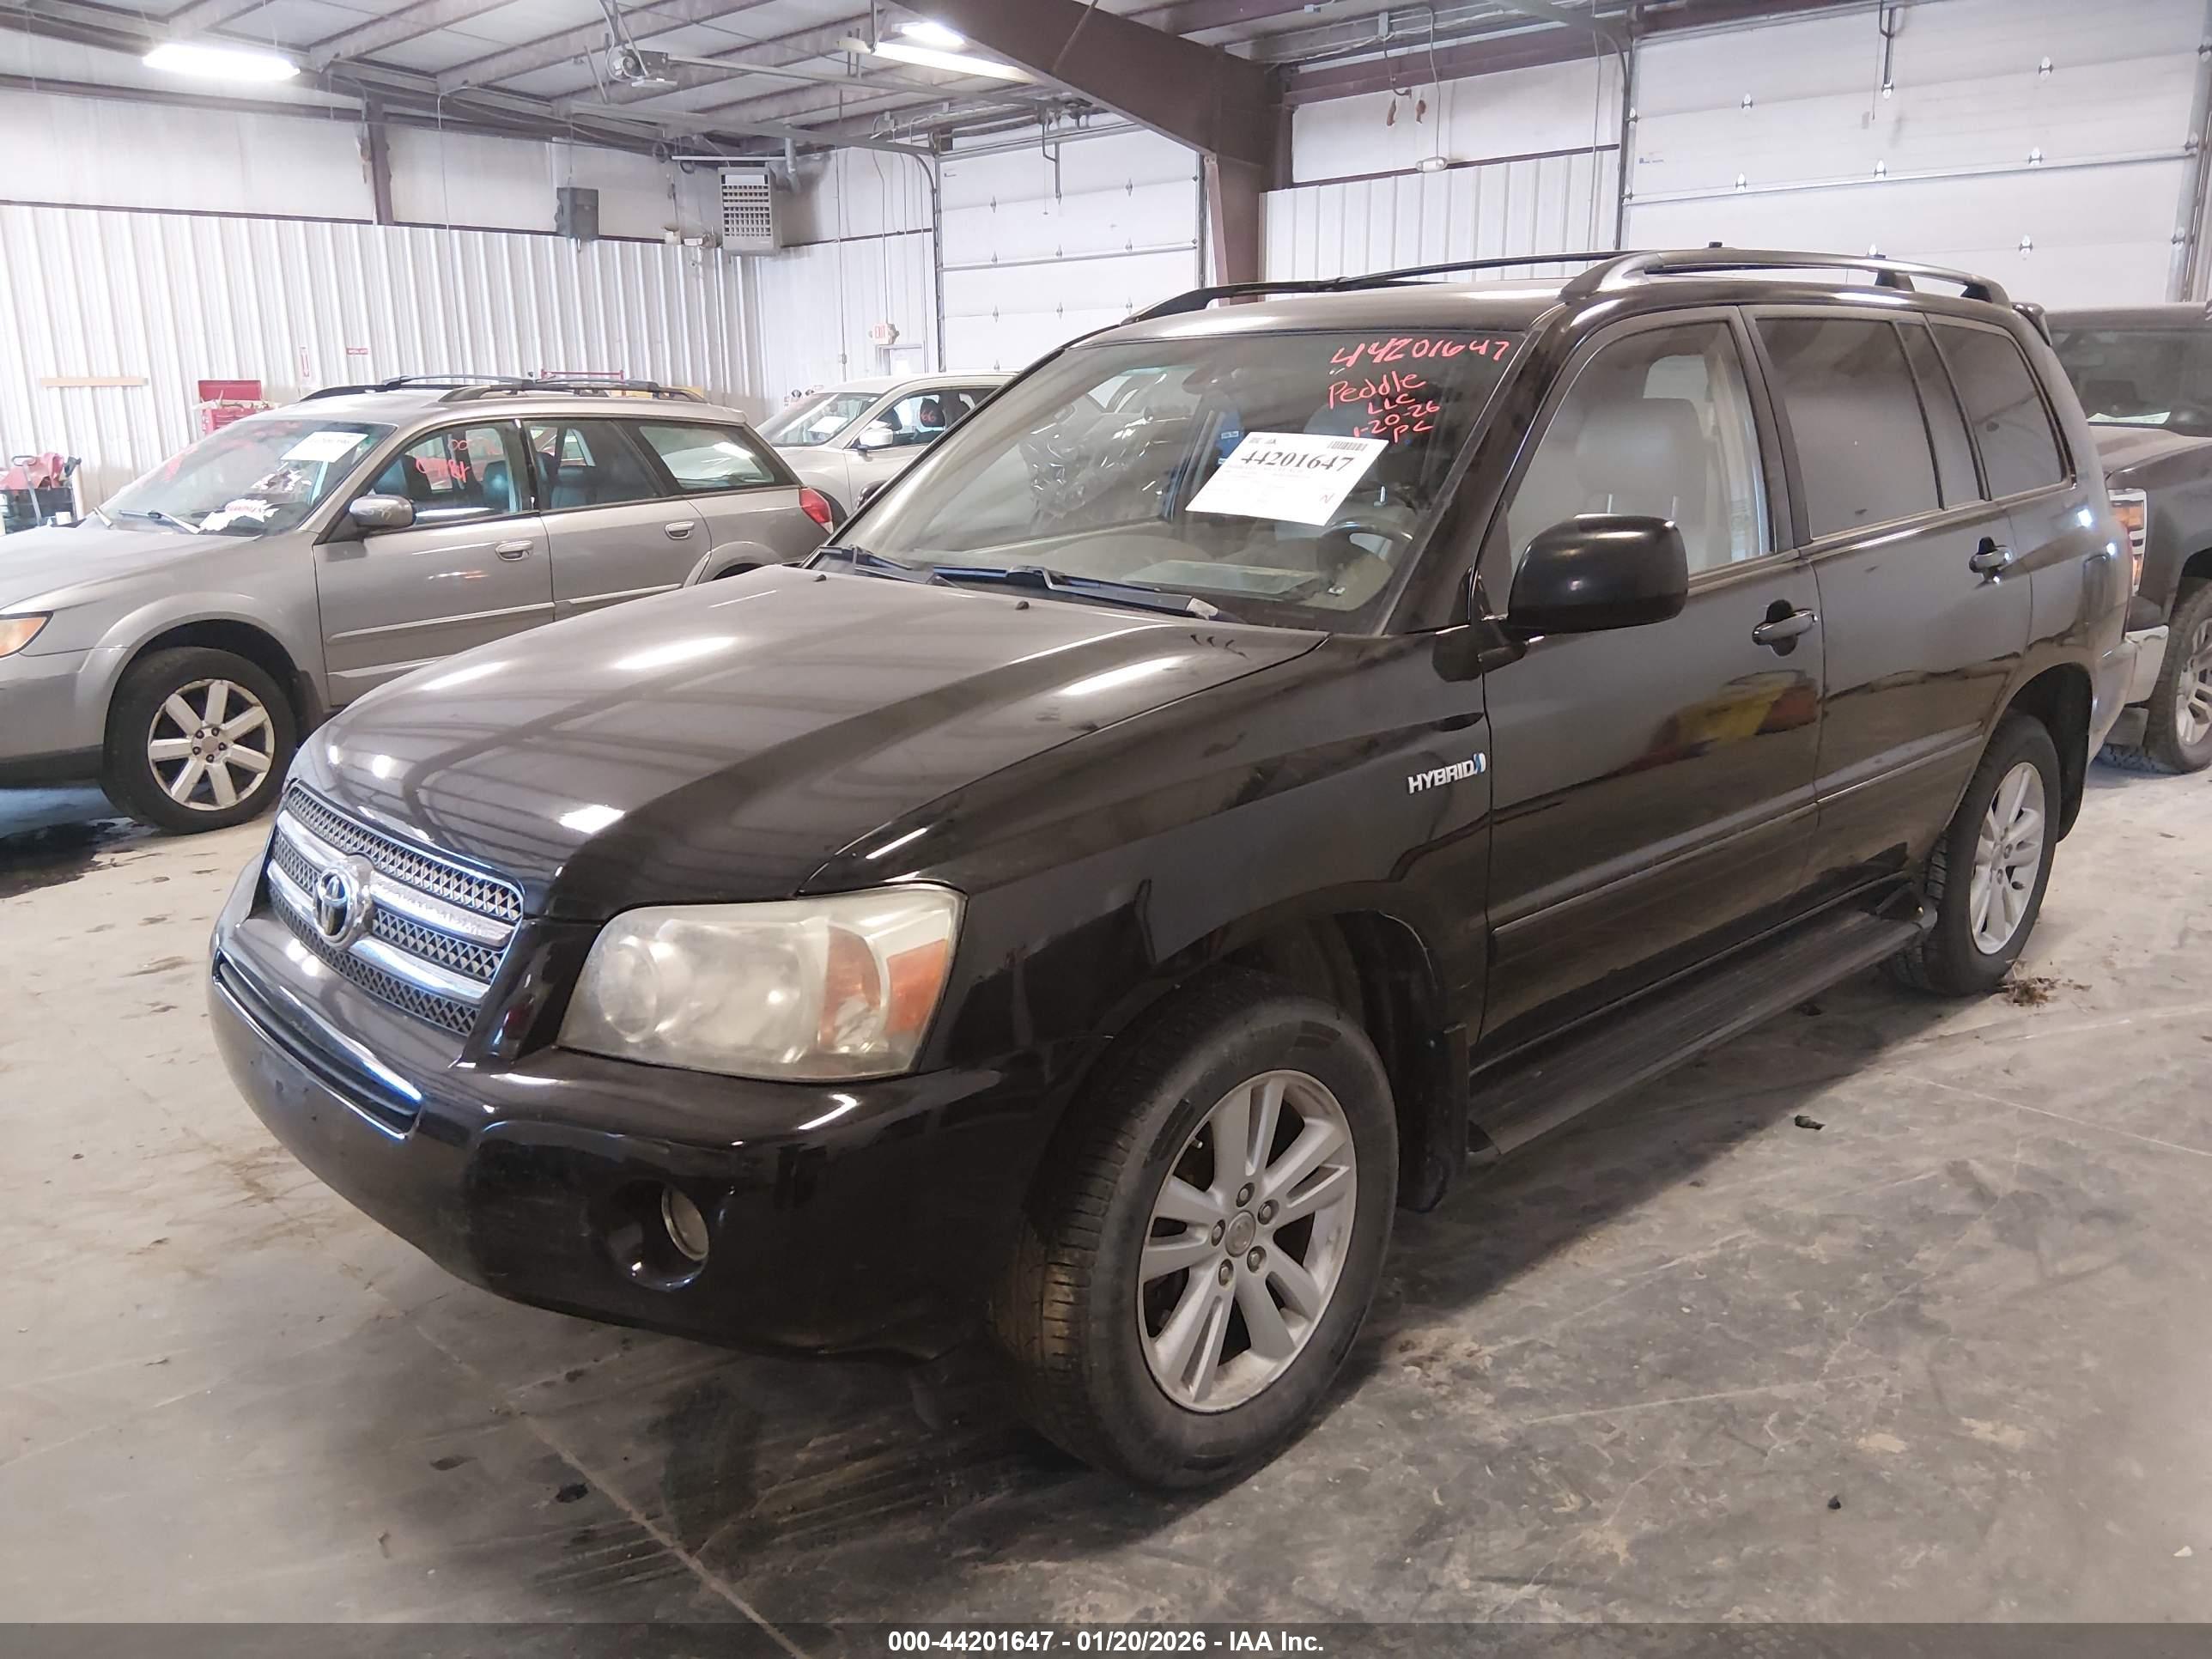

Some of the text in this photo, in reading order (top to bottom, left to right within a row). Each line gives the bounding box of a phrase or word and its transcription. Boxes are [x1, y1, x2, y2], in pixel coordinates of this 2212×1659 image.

[1330, 337, 1510, 367] 44201647
[1328, 370, 1426, 410] Peddle
[1367, 393, 1416, 415] LLC
[1353, 400, 1441, 438] 1-20-26
[1240, 451, 1355, 471] 44201647
[1407, 759, 1478, 794] HYBRID
